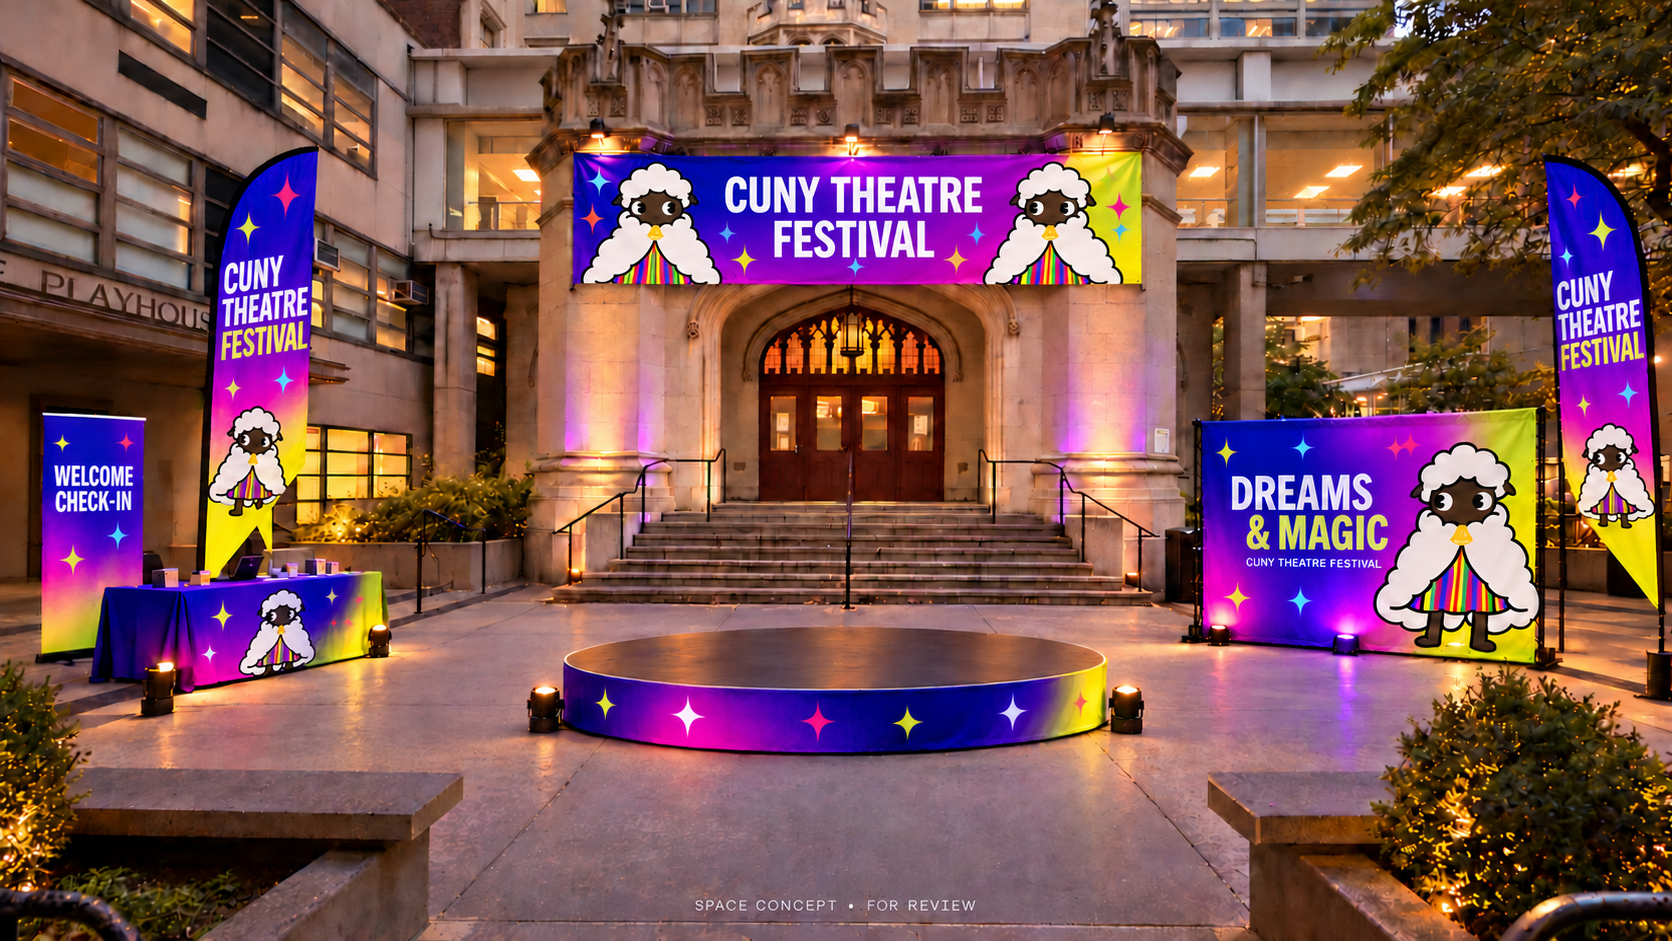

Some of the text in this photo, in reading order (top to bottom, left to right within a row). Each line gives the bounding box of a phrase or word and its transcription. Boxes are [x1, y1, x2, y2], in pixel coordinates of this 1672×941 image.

[724, 176, 983, 214] CUNY THEATRE
[773, 219, 935, 258] FESTIVAL
[223, 254, 284, 295] CUNY
[1556, 270, 1614, 311] CUNY
[221, 286, 309, 327] THEATRE
[1557, 298, 1642, 341] THEATRE
[220, 320, 309, 361] FESTIVAL
[1560, 331, 1645, 372] FESTIVAL
[53, 464, 134, 487] WELCOME
[1231, 473, 1373, 511] DREAMS
[55, 490, 132, 513] CHECK-IN
[1246, 514, 1389, 551] & MAGIC
[1245, 557, 1383, 569] CUNY THEATRE FESTIVAL
